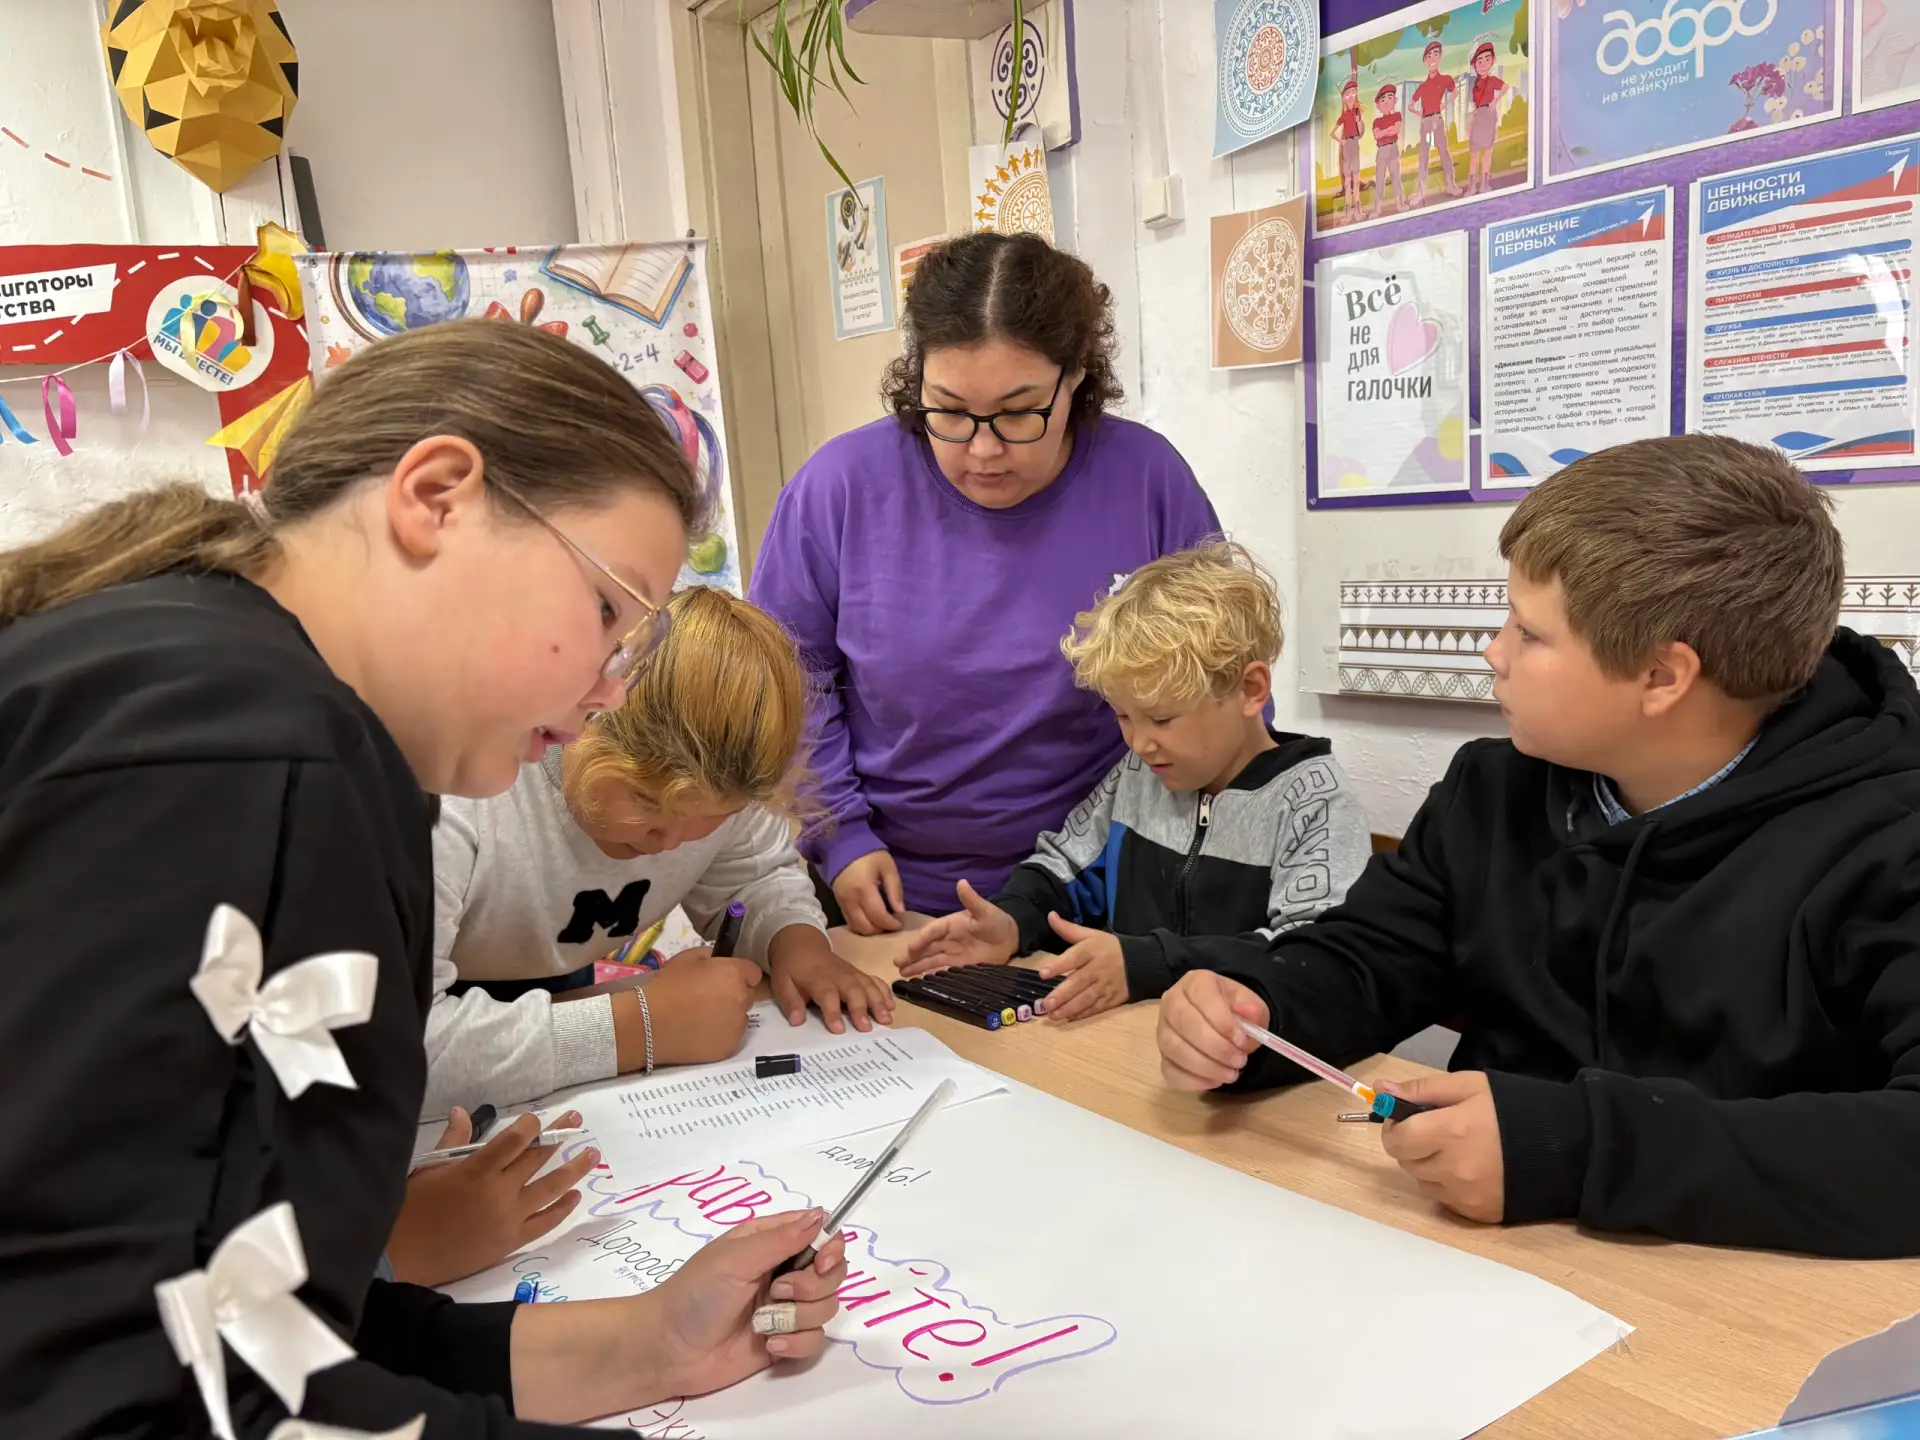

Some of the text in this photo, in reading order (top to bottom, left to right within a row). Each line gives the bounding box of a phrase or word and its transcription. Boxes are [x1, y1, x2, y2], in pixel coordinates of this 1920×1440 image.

[1620, 60, 1689, 87] не уходит
[1621, 73, 1690, 98] каникулы
[1707, 171, 1801, 200] ЦЕННОСТИ
[1707, 184, 1806, 214] ДВИЖЕНИЯ
[1494, 216, 1580, 245] ДВИЖЕНИЕ
[1717, 222, 1796, 241] СОЗИДАТЕЛЬНЫЙ ТРУД
[1494, 234, 1557, 257] ПЕРВЫХ
[1494, 260, 1658, 294] достойным наследником великих дел
[1509, 269, 1550, 281] возможность
[1576, 258, 1602, 269] лучшей
[1606, 252, 1636, 264] версией
[1716, 266, 1740, 276] ЖИЗНЬ
[1748, 258, 1800, 272] ДОСТОИНСТВО
[0, 273, 93, 298] ИГАТОРЫ
[1551, 293, 1578, 304] которых
[1581, 287, 1612, 298] отличает
[1615, 280, 1658, 292] стремление
[1583, 274, 1626, 287] основателей
[1344, 274, 1402, 322] Всё
[1502, 312, 1524, 321] победе
[1561, 300, 1602, 311] начинаниях
[1618, 290, 1658, 302] нежелание
[1716, 292, 1762, 304] ПАТРИОТИЗМ
[1494, 318, 1546, 331] останавливаться
[1580, 306, 1625, 319] достигнутом.
[1494, 331, 1530, 340] участником
[1533, 324, 1566, 336] Движения
[1592, 317, 1614, 326] выбор
[1618, 313, 1648, 322] сильных
[1714, 322, 1742, 332] ДРУЖБА
[1350, 325, 1371, 345] не
[1494, 342, 1519, 351] готовых
[1520, 338, 1546, 346] вписать
[1584, 328, 1613, 338] историю
[153, 335, 234, 386] МЫ ЕСТЕ!
[1348, 346, 1380, 375] для
[1614, 342, 1656, 355] уникальных
[1714, 352, 1790, 366] СЛУЖЕНИЕ ОТЕЧЕСТВУ
[1494, 370, 1525, 378] программ
[1528, 364, 1565, 374] воспитания
[1575, 358, 1618, 368] становления
[1494, 380, 1526, 388] активного
[1548, 370, 1599, 382] ответственного
[1608, 363, 1656, 374] молодежного
[1348, 376, 1432, 402] галочки
[1552, 382, 1581, 392] которого
[1613, 374, 1647, 386] уважение
[1713, 390, 1767, 400] КРЕПКАЯ СЕМЬЯ
[1494, 398, 1528, 406] традициям
[1549, 392, 1582, 402] культурам
[1591, 388, 1620, 396] народов
[1494, 406, 1536, 416] историческая
[1563, 398, 1622, 409] преемственность
[1494, 416, 1544, 426] сопричастность
[1556, 411, 1582, 420] судьбой
[1626, 404, 1656, 412] которой
[1521, 423, 1555, 432] ценностью
[1598, 417, 1618, 426] будет
[557, 879, 651, 944] M
